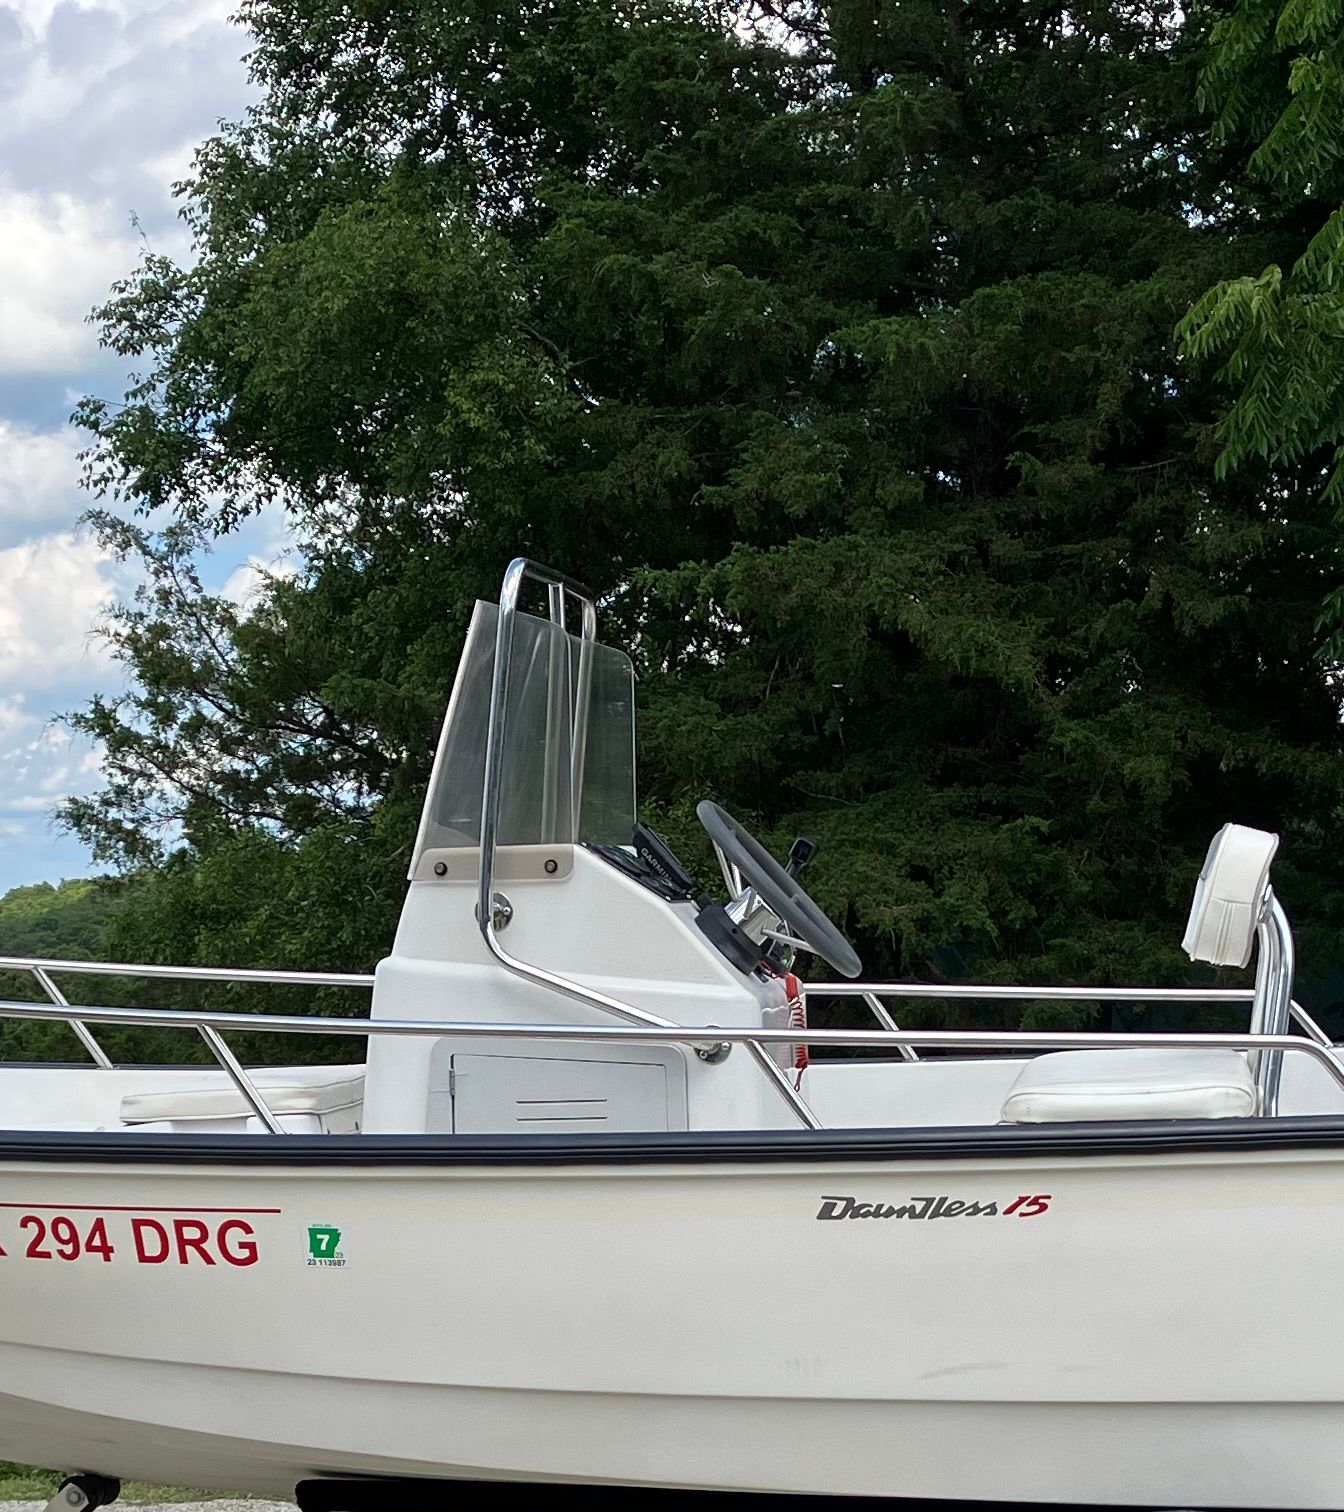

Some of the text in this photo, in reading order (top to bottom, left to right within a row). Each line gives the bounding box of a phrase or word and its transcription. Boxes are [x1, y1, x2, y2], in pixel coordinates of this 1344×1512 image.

[640, 847, 673, 880] GARMIN
[1002, 1194, 1054, 1218] 15
[19, 1214, 116, 1263] 294
[131, 1217, 260, 1268] DRG
[316, 1233, 330, 1251] 7
